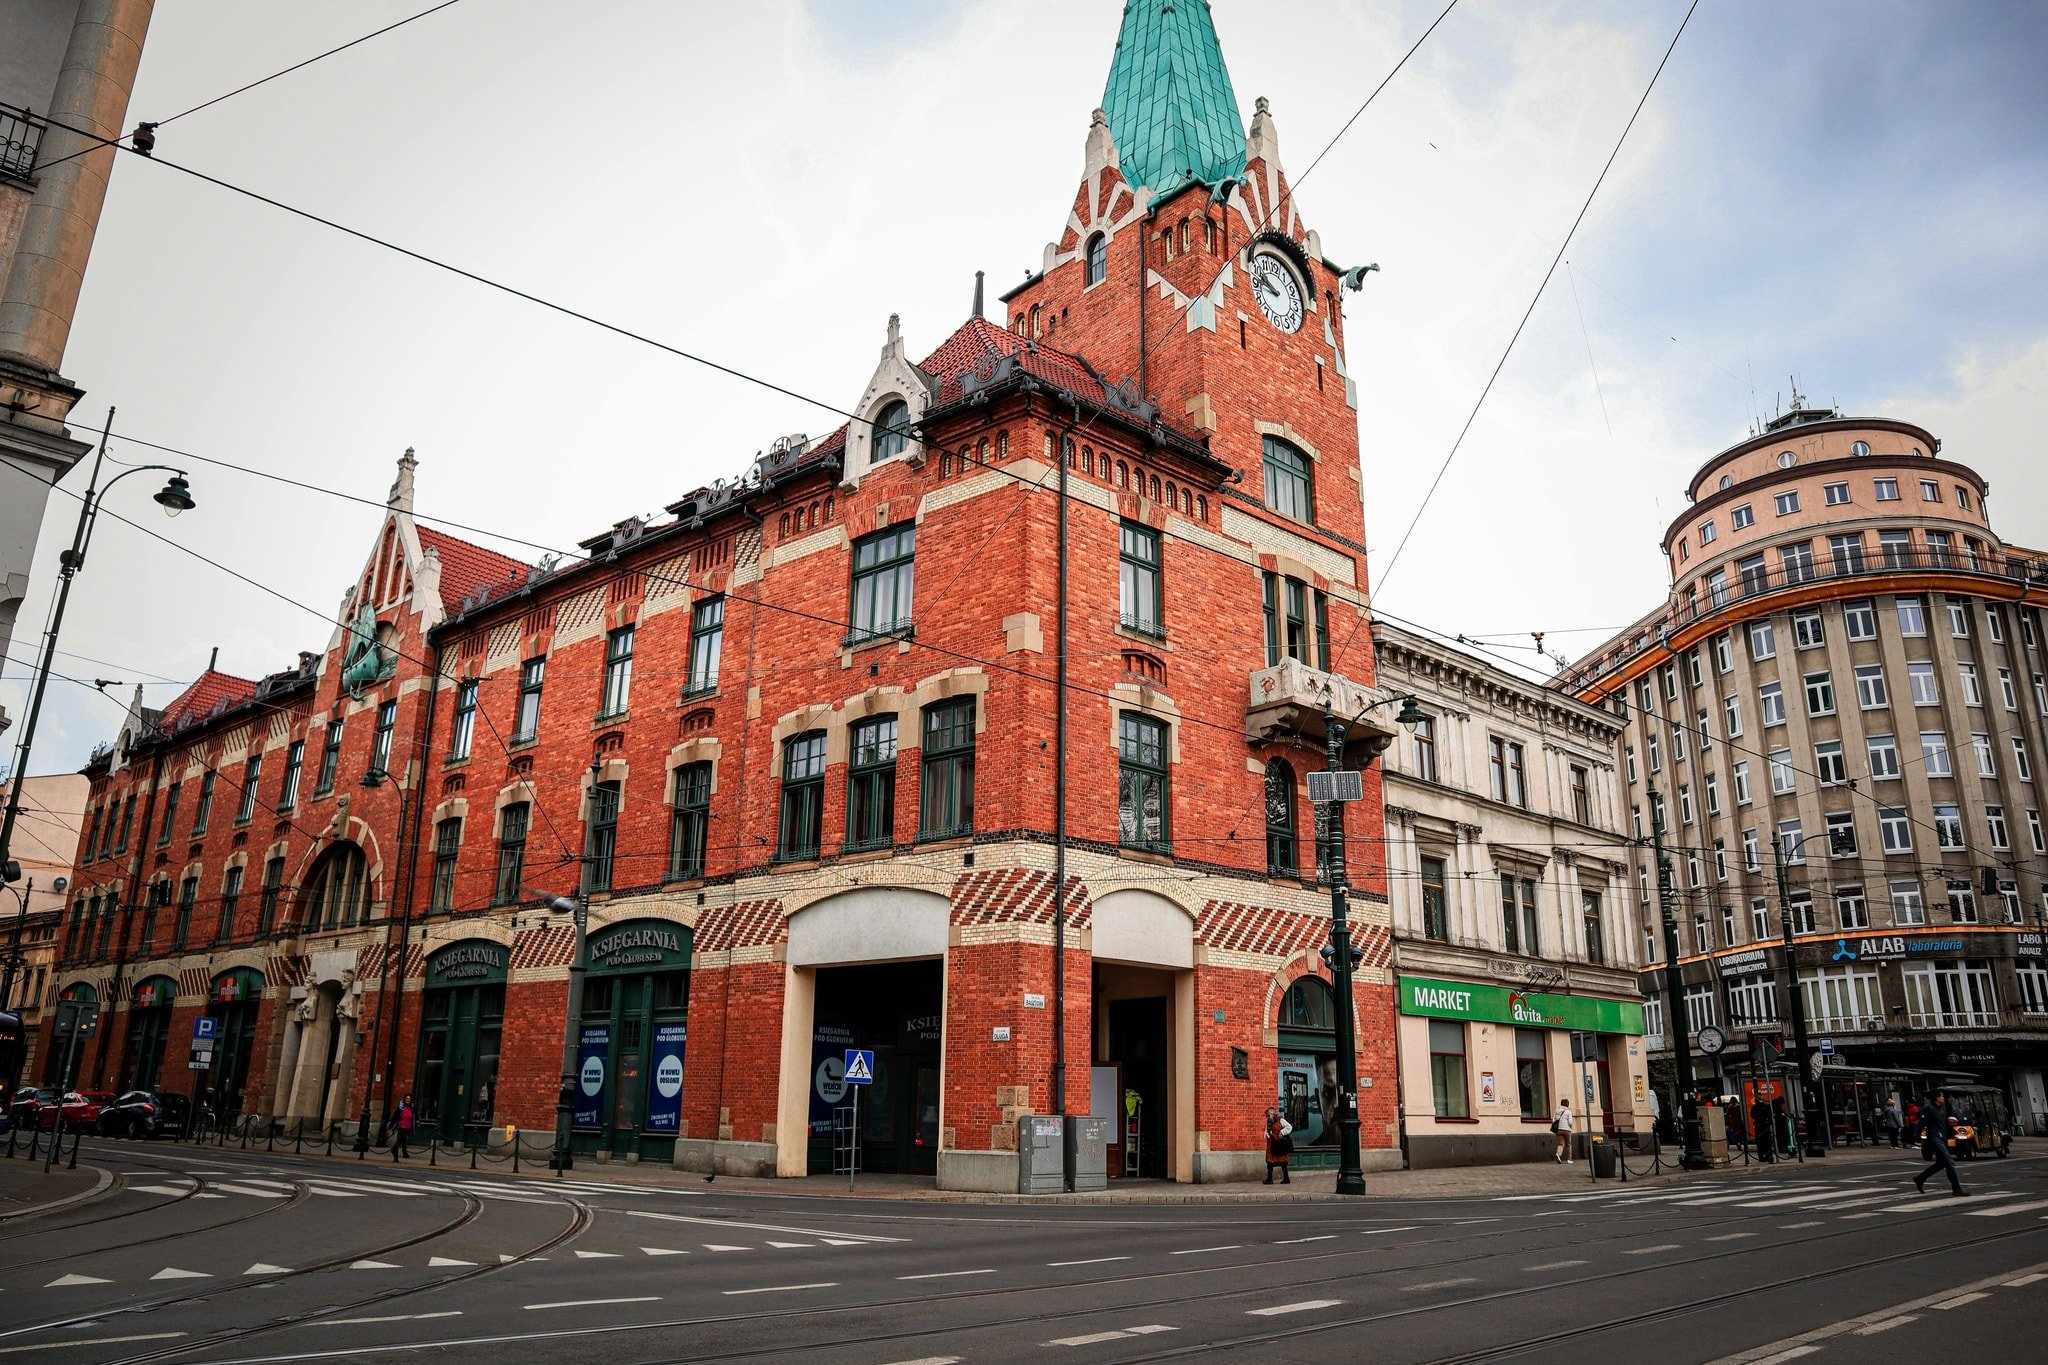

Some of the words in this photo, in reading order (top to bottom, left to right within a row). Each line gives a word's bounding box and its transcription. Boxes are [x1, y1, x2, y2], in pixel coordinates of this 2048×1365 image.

[1262, 259, 1268, 271] 11
[1270, 261, 1279, 276] 12
[1252, 276, 1258, 288] 9
[1282, 273, 1286, 285] 1
[1289, 285, 1296, 297] 2
[1256, 294, 1262, 306] 8
[1264, 306, 1270, 318] 7
[1292, 301, 1299, 312] 3
[1274, 316, 1280, 327] 6
[1284, 318, 1290, 329] 5
[1290, 313, 1296, 323] 4
[591, 930, 680, 961] KSIĘGARNIA
[1860, 938, 1906, 954] ALAB
[1908, 940, 1963, 952] laboratoria
[434, 948, 500, 974] KSIĘGARNIA
[606, 955, 620, 966] POD
[1719, 950, 1766, 966] LABORATORIUM
[220, 983, 240, 996] mBank
[1414, 987, 1471, 1012] MARKET
